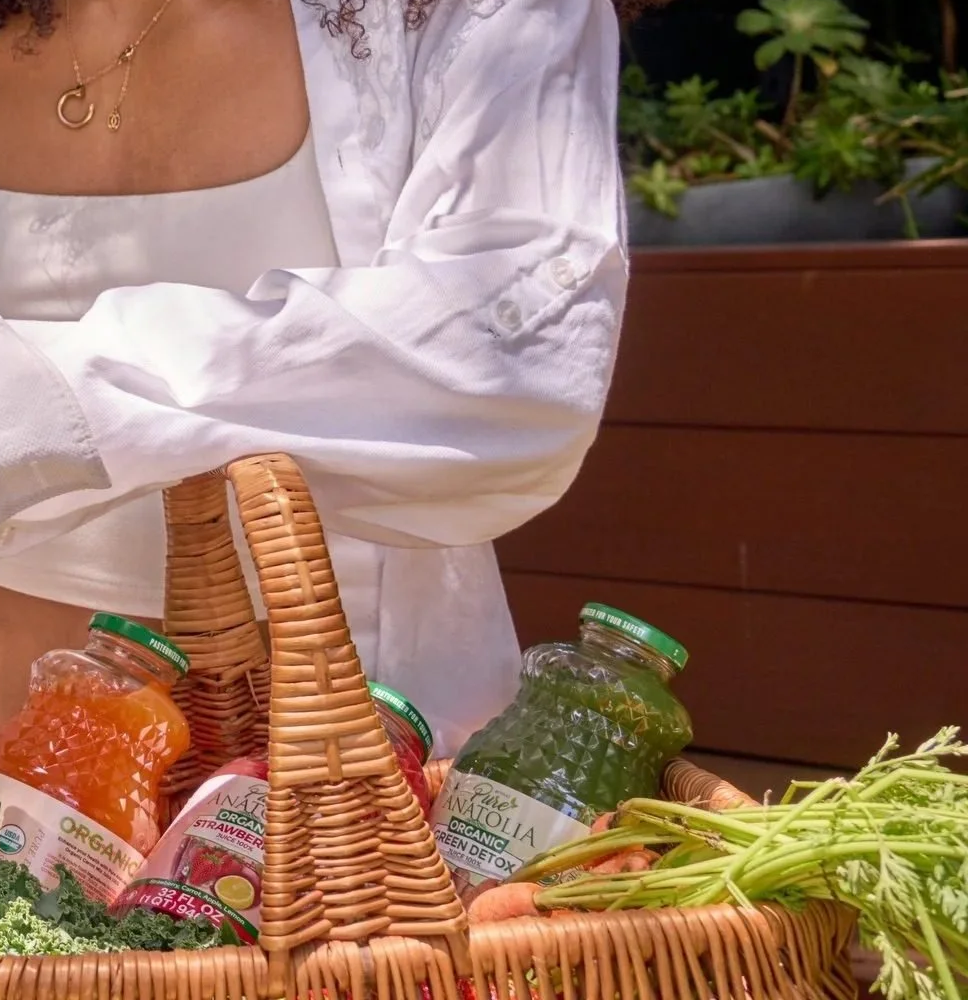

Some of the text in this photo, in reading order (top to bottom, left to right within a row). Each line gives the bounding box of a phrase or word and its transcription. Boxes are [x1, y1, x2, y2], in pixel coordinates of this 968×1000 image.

[596, 610, 606, 620] FOR
[606, 614, 622, 627] YOUR
[622, 620, 645, 637] SAFETY
[149, 638, 180, 664] PASTEURIZED
[408, 710, 419, 724] FOR
[207, 792, 266, 818] ANAT
[470, 782, 510, 812] Pure
[4, 829, 20, 842] USDA
[193, 819, 264, 850] STRAWBER
[442, 795, 536, 848] ANATOLIA
[450, 819, 505, 850] ORGANIC
[60, 816, 139, 878] ORGANIC
[216, 832, 254, 852] JUICE 100%
[434, 830, 468, 852] GREEN
[470, 844, 517, 874] DETOX
[446, 848, 466, 861] JUICE
[466, 854, 482, 868] 100%
[158, 888, 225, 923] 32 FL OZ
[181, 885, 202, 898] Carrot,
[202, 894, 223, 910] Apple,
[223, 906, 245, 925] Lemon
